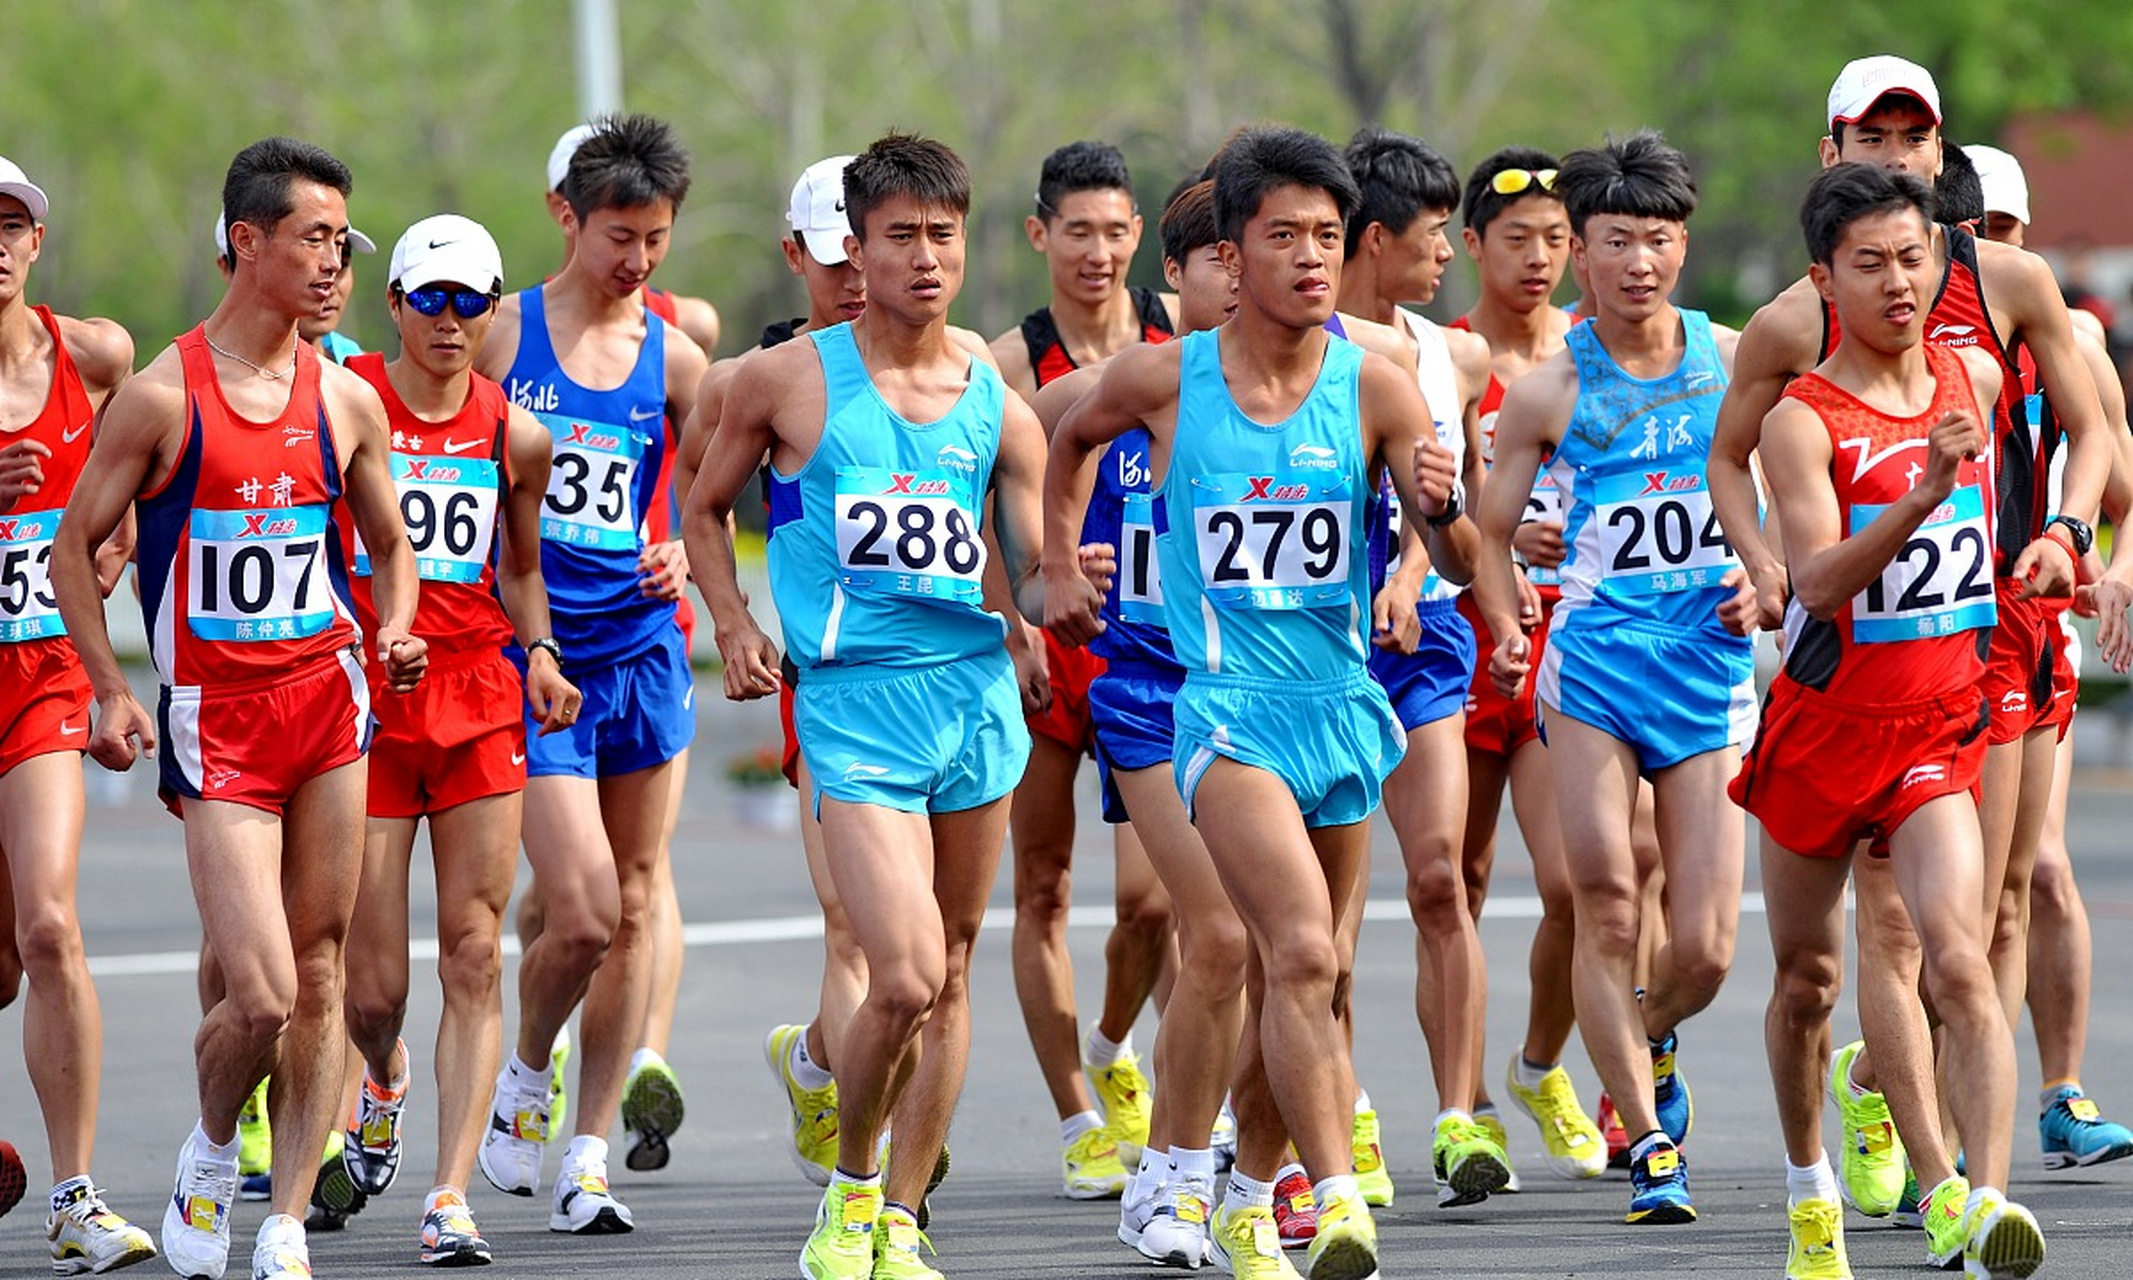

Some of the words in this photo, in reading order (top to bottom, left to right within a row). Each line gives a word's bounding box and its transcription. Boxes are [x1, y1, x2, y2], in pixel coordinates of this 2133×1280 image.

[1930, 336, 1978, 347] I-NING
[1629, 415, 1693, 460] 青海
[1119, 451, 1152, 487] 河
[1290, 459, 1337, 468] LI-NING
[234, 471, 296, 507] 甘肃
[847, 501, 979, 574] 288
[1208, 508, 1340, 581] 279
[1608, 501, 1735, 571] 204
[201, 540, 319, 614] 107
